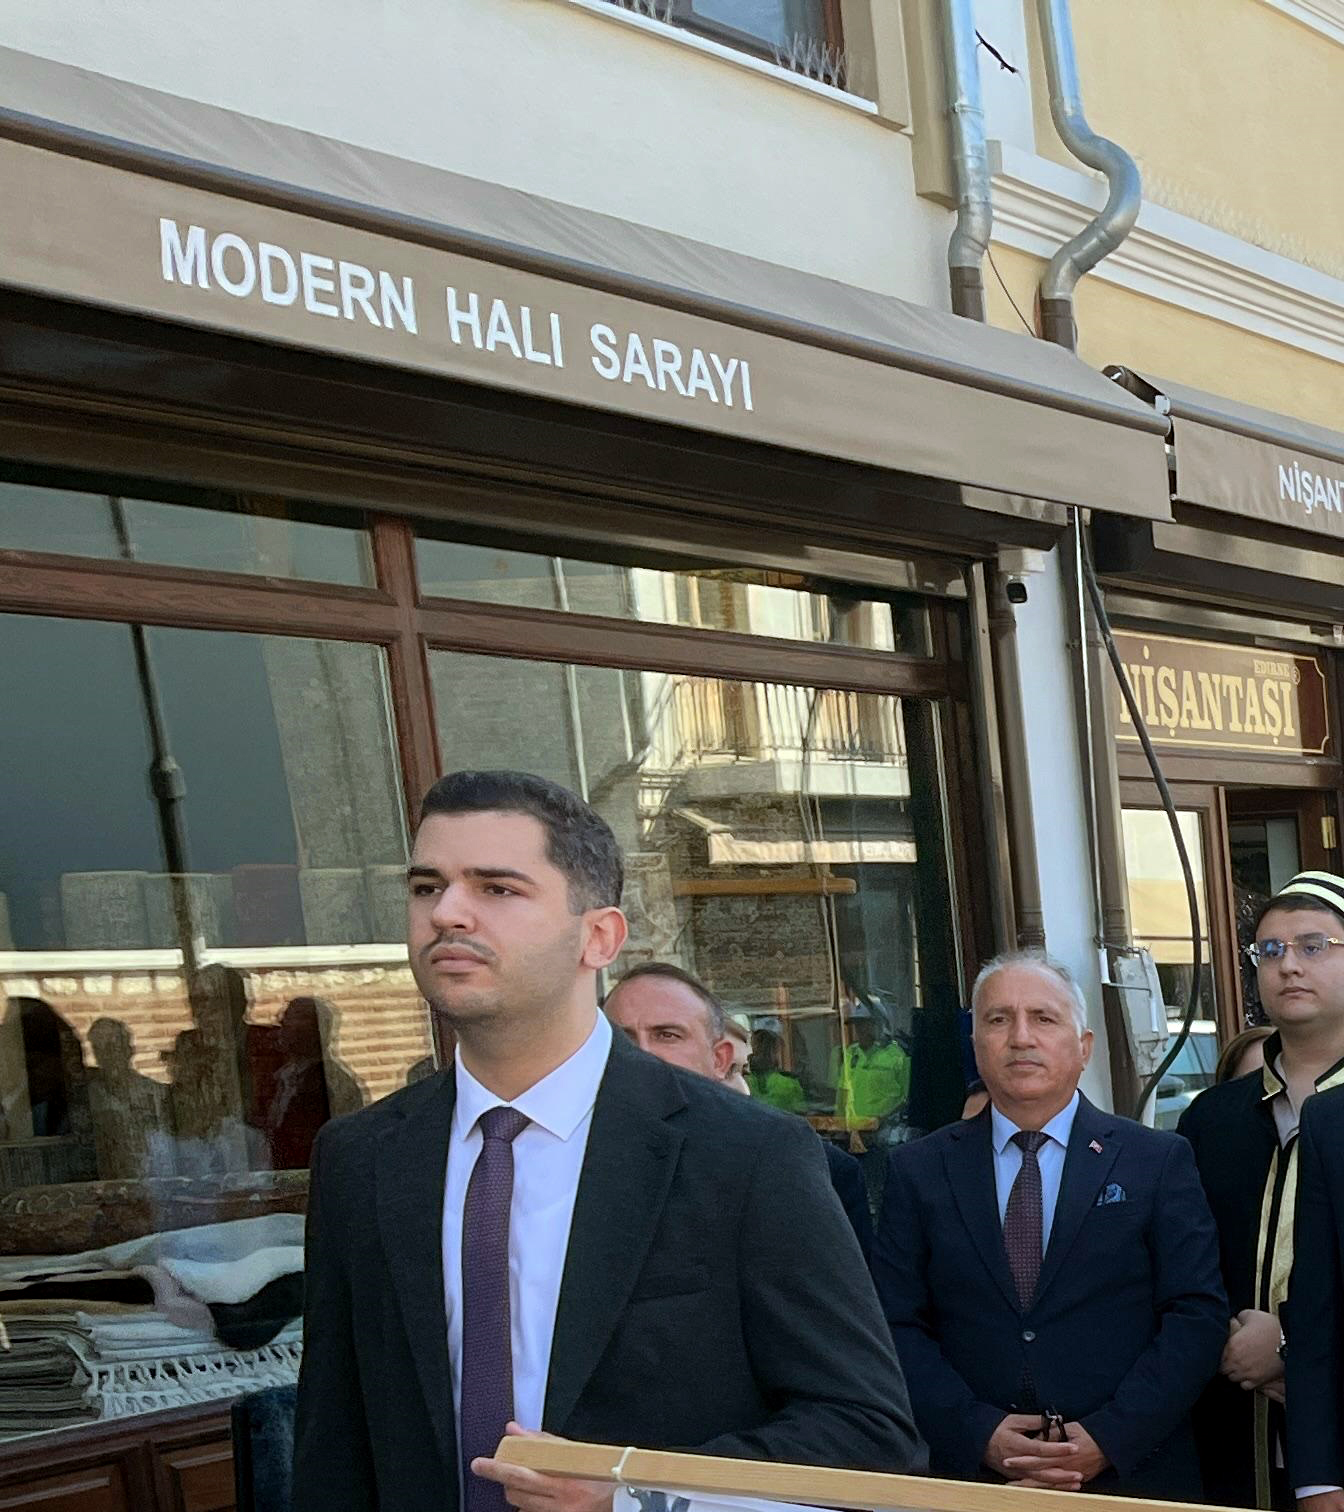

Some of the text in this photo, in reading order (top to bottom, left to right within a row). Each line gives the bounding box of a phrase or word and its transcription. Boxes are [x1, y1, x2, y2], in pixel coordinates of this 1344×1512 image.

[158, 217, 755, 412] MODERN HALI SARAYI
[1119, 644, 1296, 745] NİŞANTAŞI
